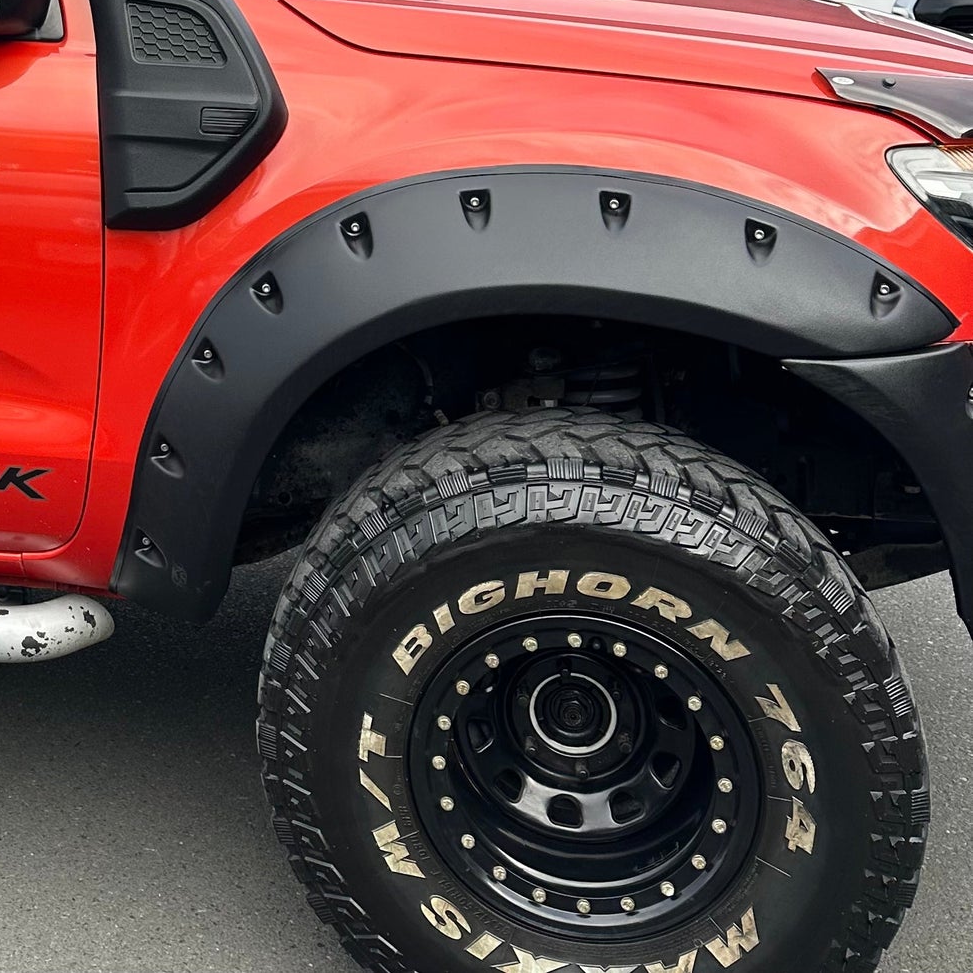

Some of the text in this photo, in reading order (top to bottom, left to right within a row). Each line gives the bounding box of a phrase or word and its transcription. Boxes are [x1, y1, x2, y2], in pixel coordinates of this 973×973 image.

[359, 711, 426, 878] M/T
[392, 569, 751, 675] BIGHORN
[754, 683, 817, 854] 764
